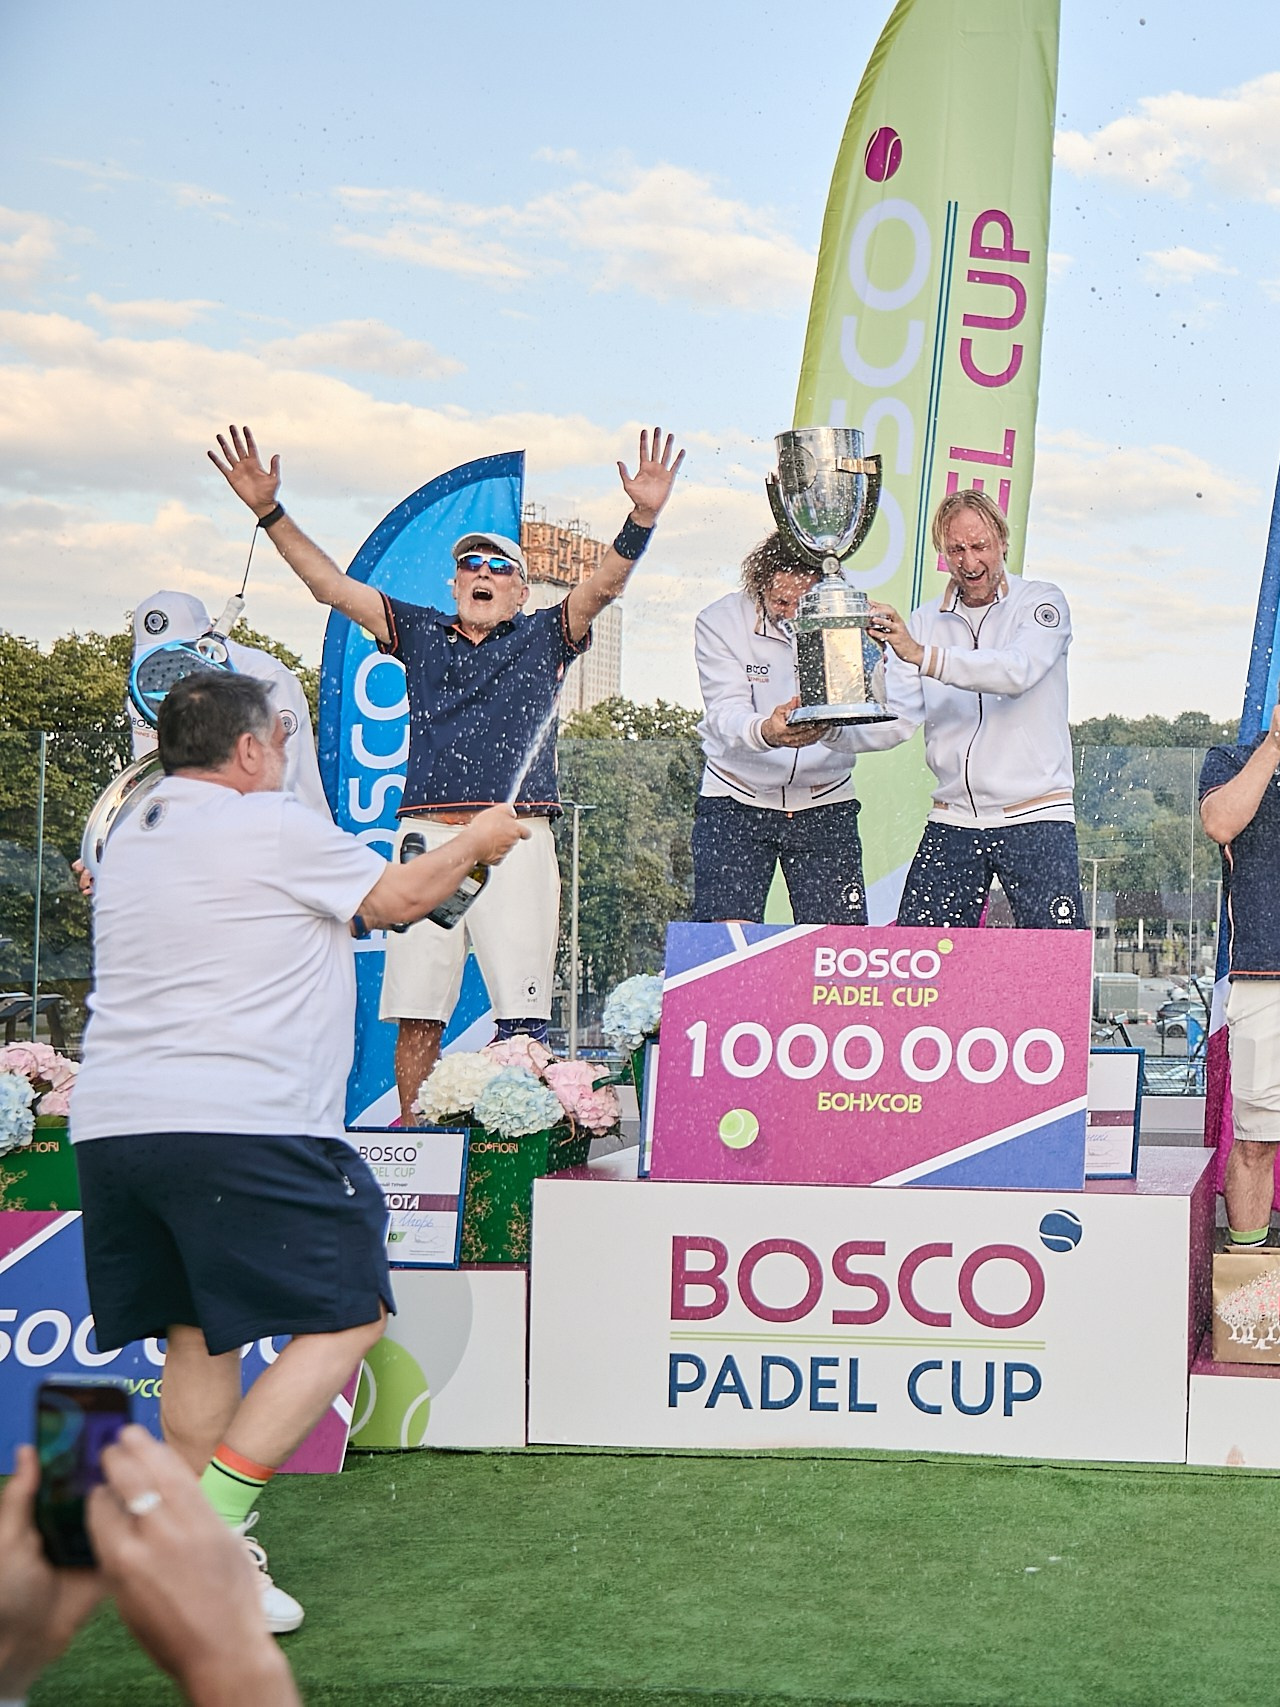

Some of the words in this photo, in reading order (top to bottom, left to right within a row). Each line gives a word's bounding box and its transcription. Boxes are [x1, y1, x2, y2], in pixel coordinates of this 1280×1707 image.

[959, 208, 1031, 388] CUP
[814, 947, 942, 979] BOSCO
[812, 985, 884, 1008] PADEL
[892, 986, 939, 1008] CUP
[901, 1025, 1066, 1085] 000
[817, 1091, 923, 1114] БОНУСОВ
[359, 1146, 417, 1162] BOSCO
[394, 1168, 416, 1179] CUP
[669, 1234, 1046, 1330] BOSCO
[668, 1352, 878, 1413] PADEL
[907, 1359, 1043, 1418] CUP
